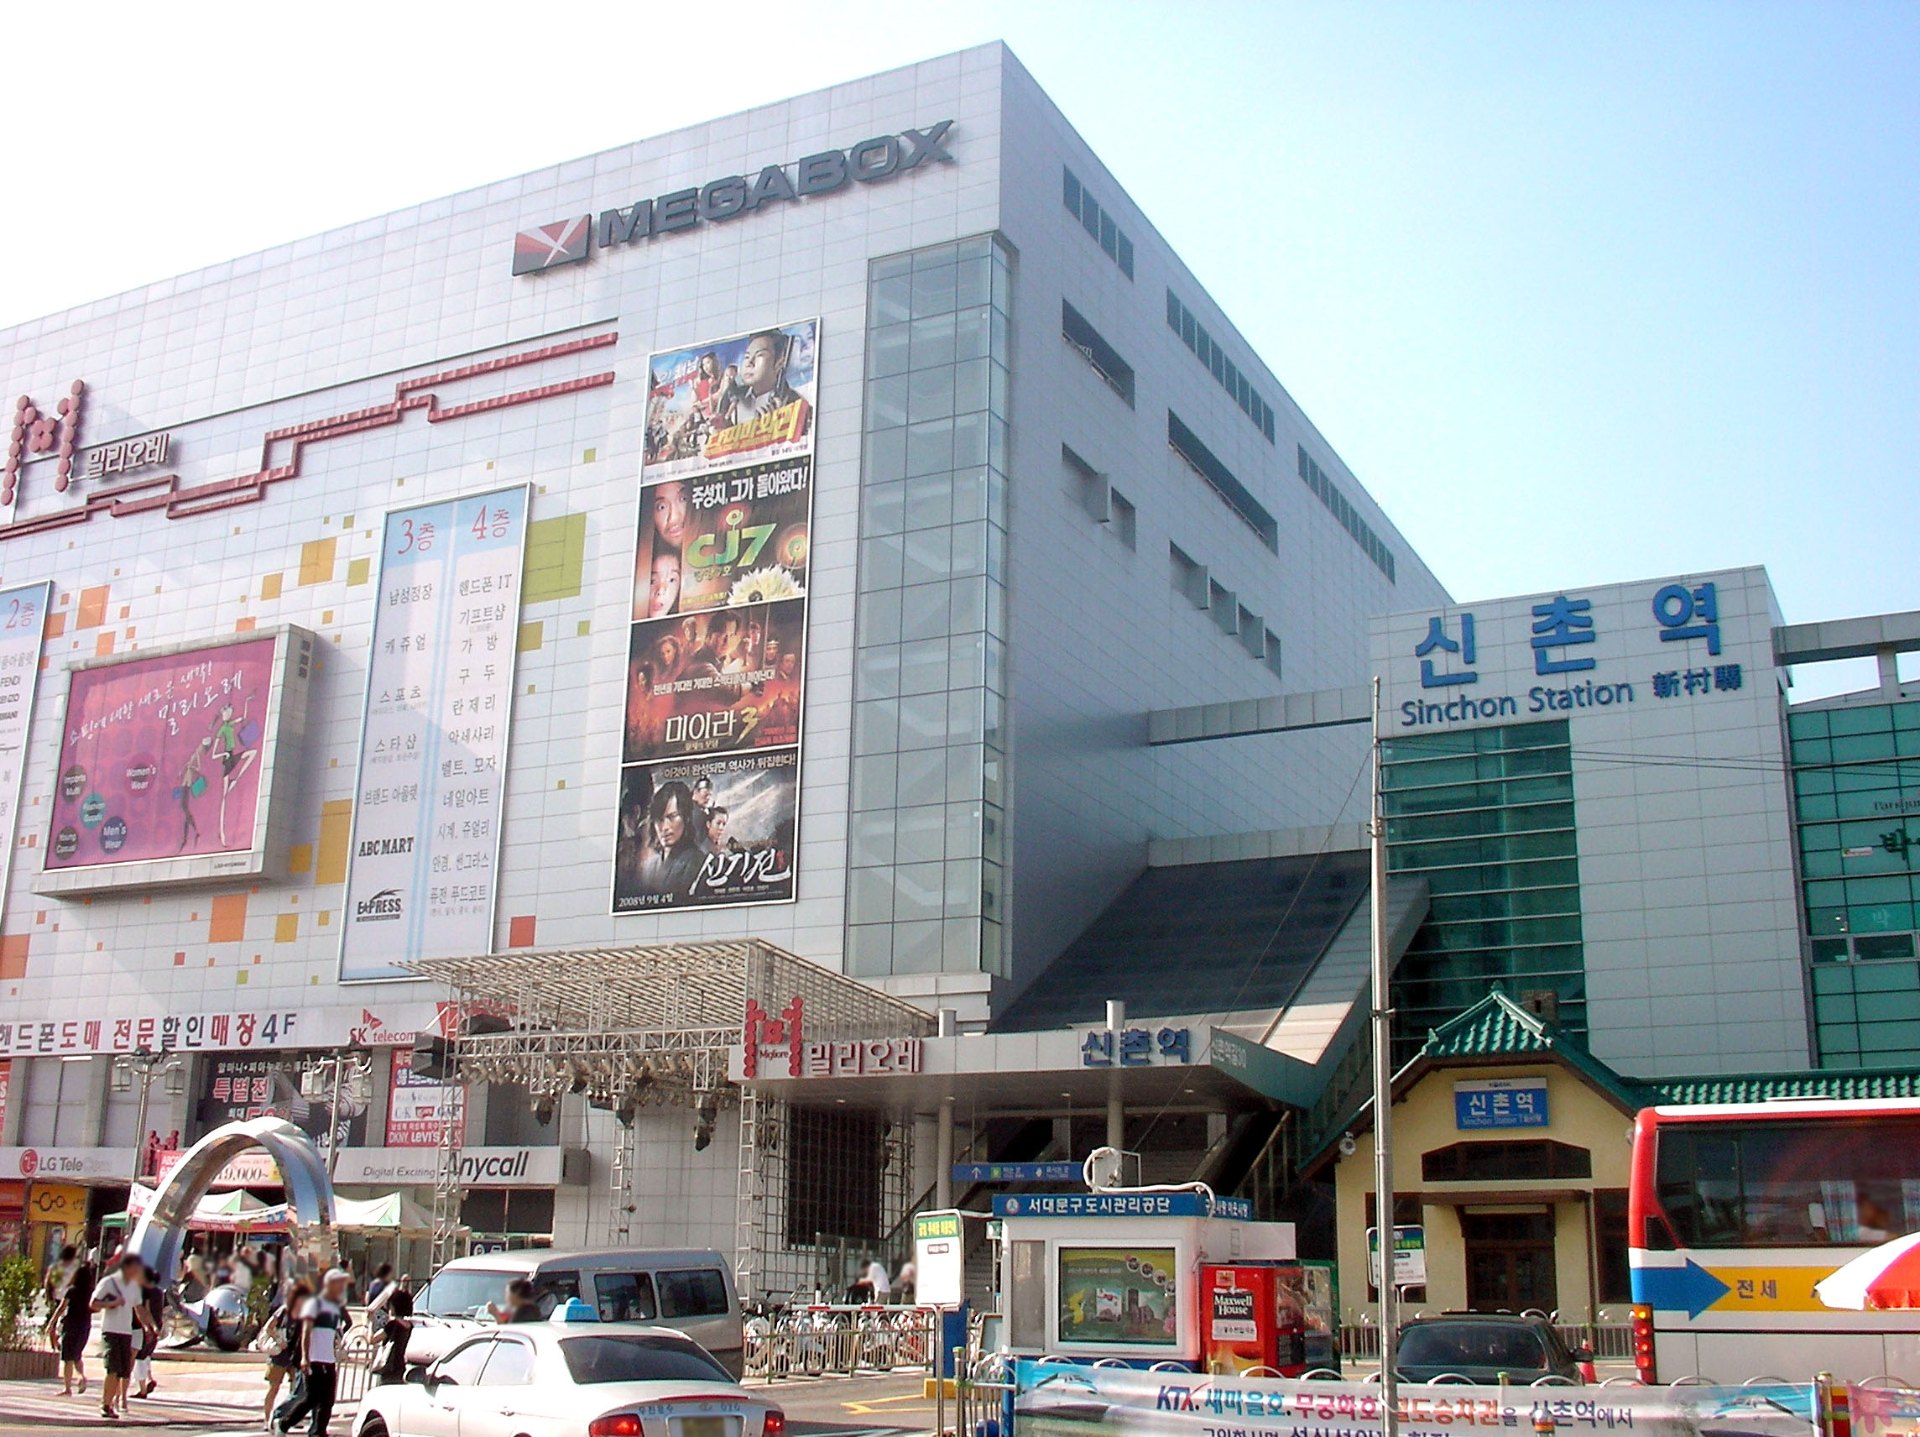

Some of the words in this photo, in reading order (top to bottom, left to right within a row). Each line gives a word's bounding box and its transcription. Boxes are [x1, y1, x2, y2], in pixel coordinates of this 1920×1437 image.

[600, 119, 954, 247] MEGABOX
[87, 433, 170, 479] 밀리오레
[730, 476, 755, 503] 그가
[756, 466, 809, 498] 돌아왔다!
[471, 504, 510, 541] 4층
[397, 518, 435, 555] 3층
[686, 509, 777, 568] CJ7
[389, 583, 433, 606] 남성정장
[5, 598, 35, 630] 2층
[459, 604, 507, 626] 기프트샵
[379, 685, 422, 704] 스포츠
[1401, 692, 1517, 727] Sinchon
[1528, 680, 1634, 713] Station
[448, 725, 495, 746] 악세사리
[665, 710, 737, 743] 미이라
[735, 706, 760, 745] 3
[473, 754, 497, 774] 모자
[728, 757, 755, 772] 역사가
[363, 787, 390, 806] 브랜드
[391, 784, 418, 803] 아울렛
[442, 788, 489, 808] 네일아트
[103, 822, 128, 836] Men's
[358, 838, 380, 857] ABC
[380, 837, 414, 855] MART
[688, 848, 792, 896] 신기전
[349, 1027, 368, 1043] SK
[373, 1031, 416, 1043] telecom
[1081, 1026, 1190, 1067] 신촌역
[809, 1038, 923, 1077] 밀리오레
[212, 1077, 270, 1104] 특별전
[1468, 1091, 1534, 1116] 신촌역
[39, 1157, 57, 1171] LG
[363, 1166, 395, 1179] Digital
[396, 1166, 436, 1179] Exciting
[441, 1151, 529, 1182] Anycall
[1214, 1294, 1253, 1306] Maxwell
[1736, 1278, 1777, 1300] 전세
[1219, 1304, 1249, 1316] House
[1295, 1393, 1380, 1421] 무궁화호
